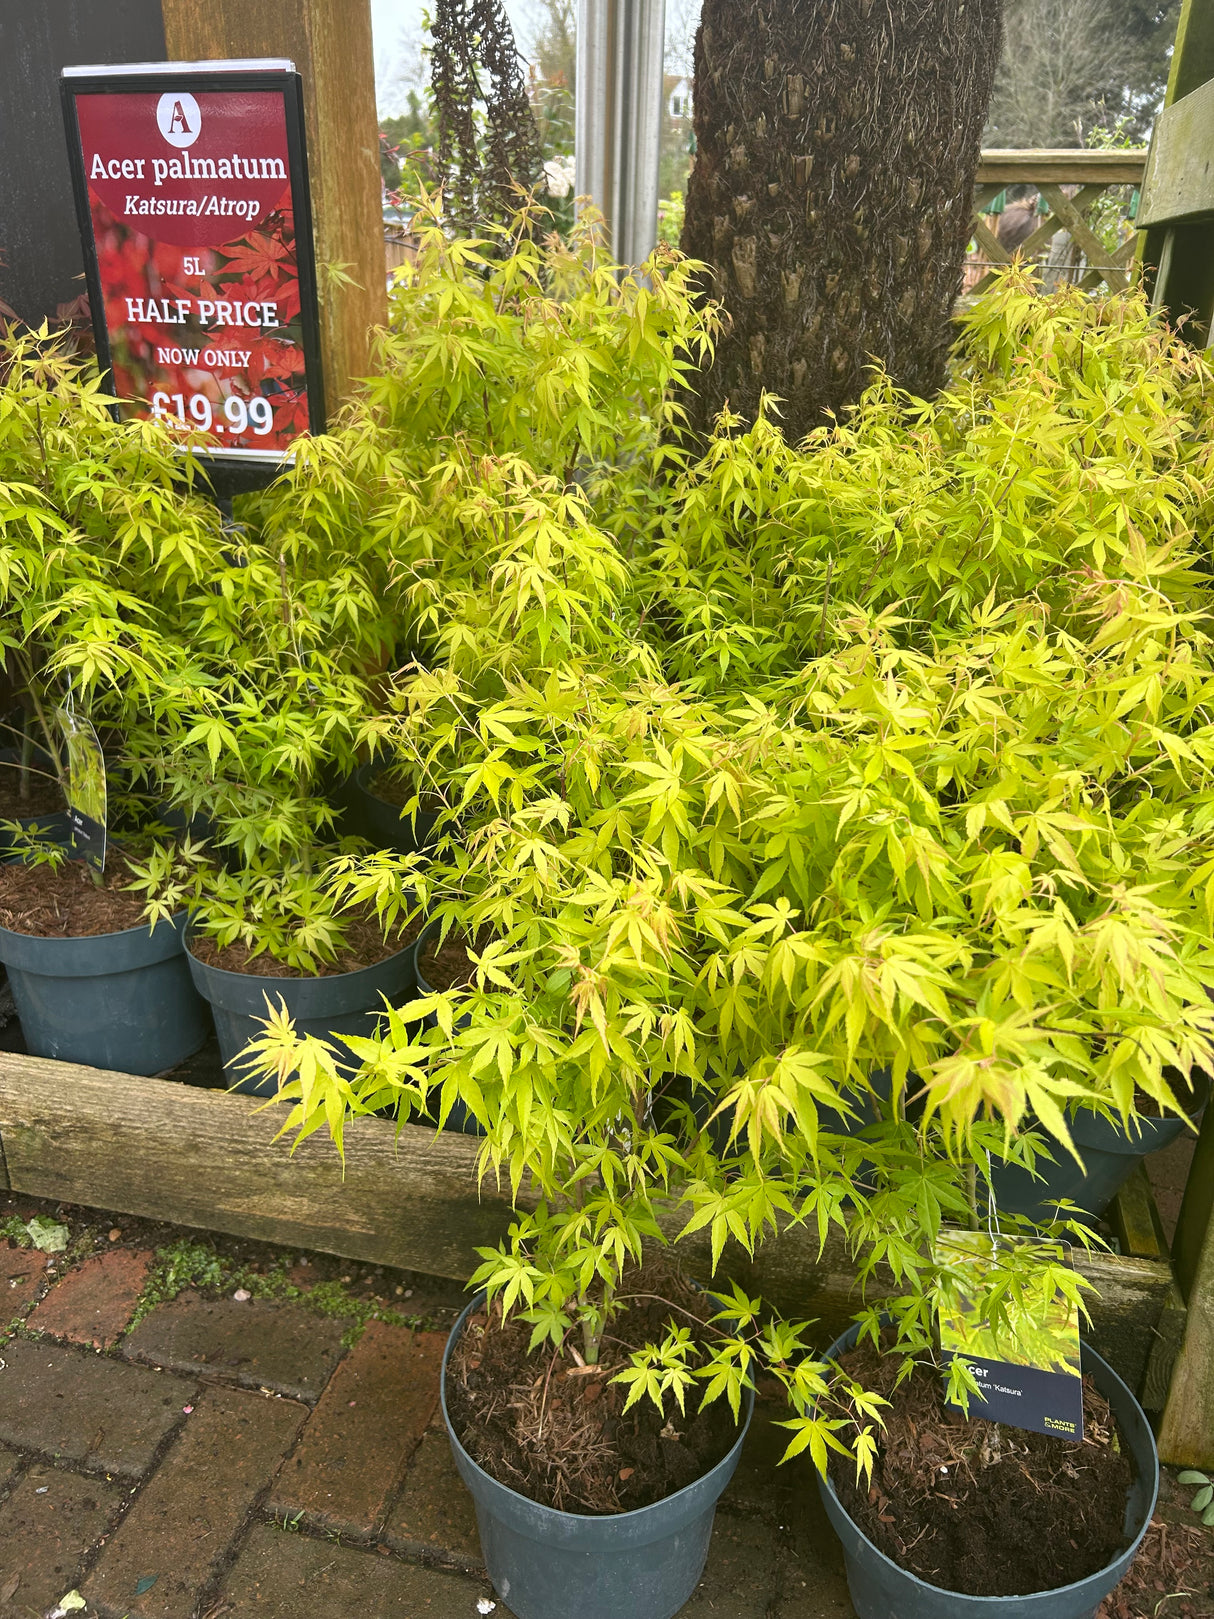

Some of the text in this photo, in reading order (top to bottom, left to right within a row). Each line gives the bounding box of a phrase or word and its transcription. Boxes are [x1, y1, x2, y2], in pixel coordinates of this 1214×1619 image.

[90, 151, 287, 186] Acer palmatum
[124, 195, 260, 221] Katsura/Atrop
[183, 257, 206, 276] 5L
[125, 298, 279, 327] HALF PRICE
[157, 347, 252, 368] NOW ONLY
[151, 391, 274, 435] £19.99
[963, 1365, 989, 1378] cer
